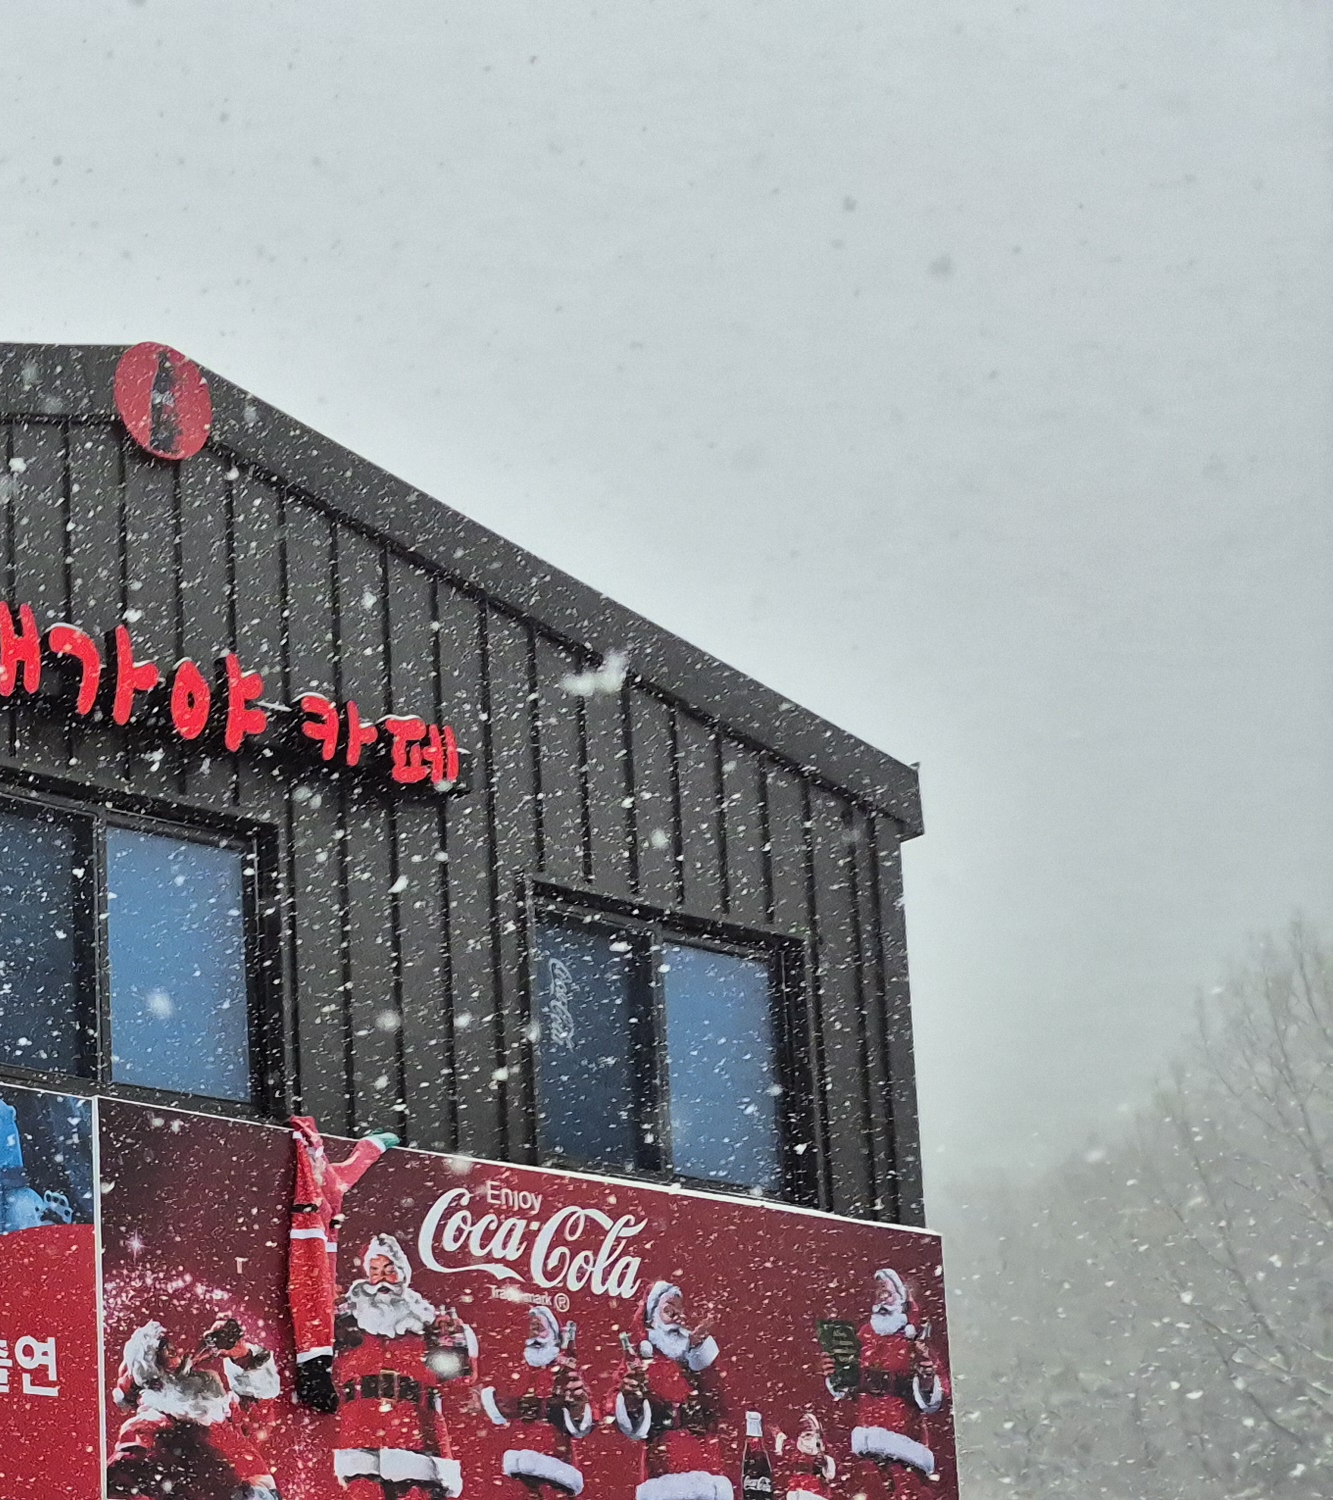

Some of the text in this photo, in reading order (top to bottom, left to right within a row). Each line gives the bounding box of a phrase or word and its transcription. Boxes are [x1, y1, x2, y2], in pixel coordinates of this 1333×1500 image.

[300, 695, 458, 784] 카페
[486, 1181, 542, 1215] Enjoy
[418, 1188, 648, 1298] Coca-Cola
